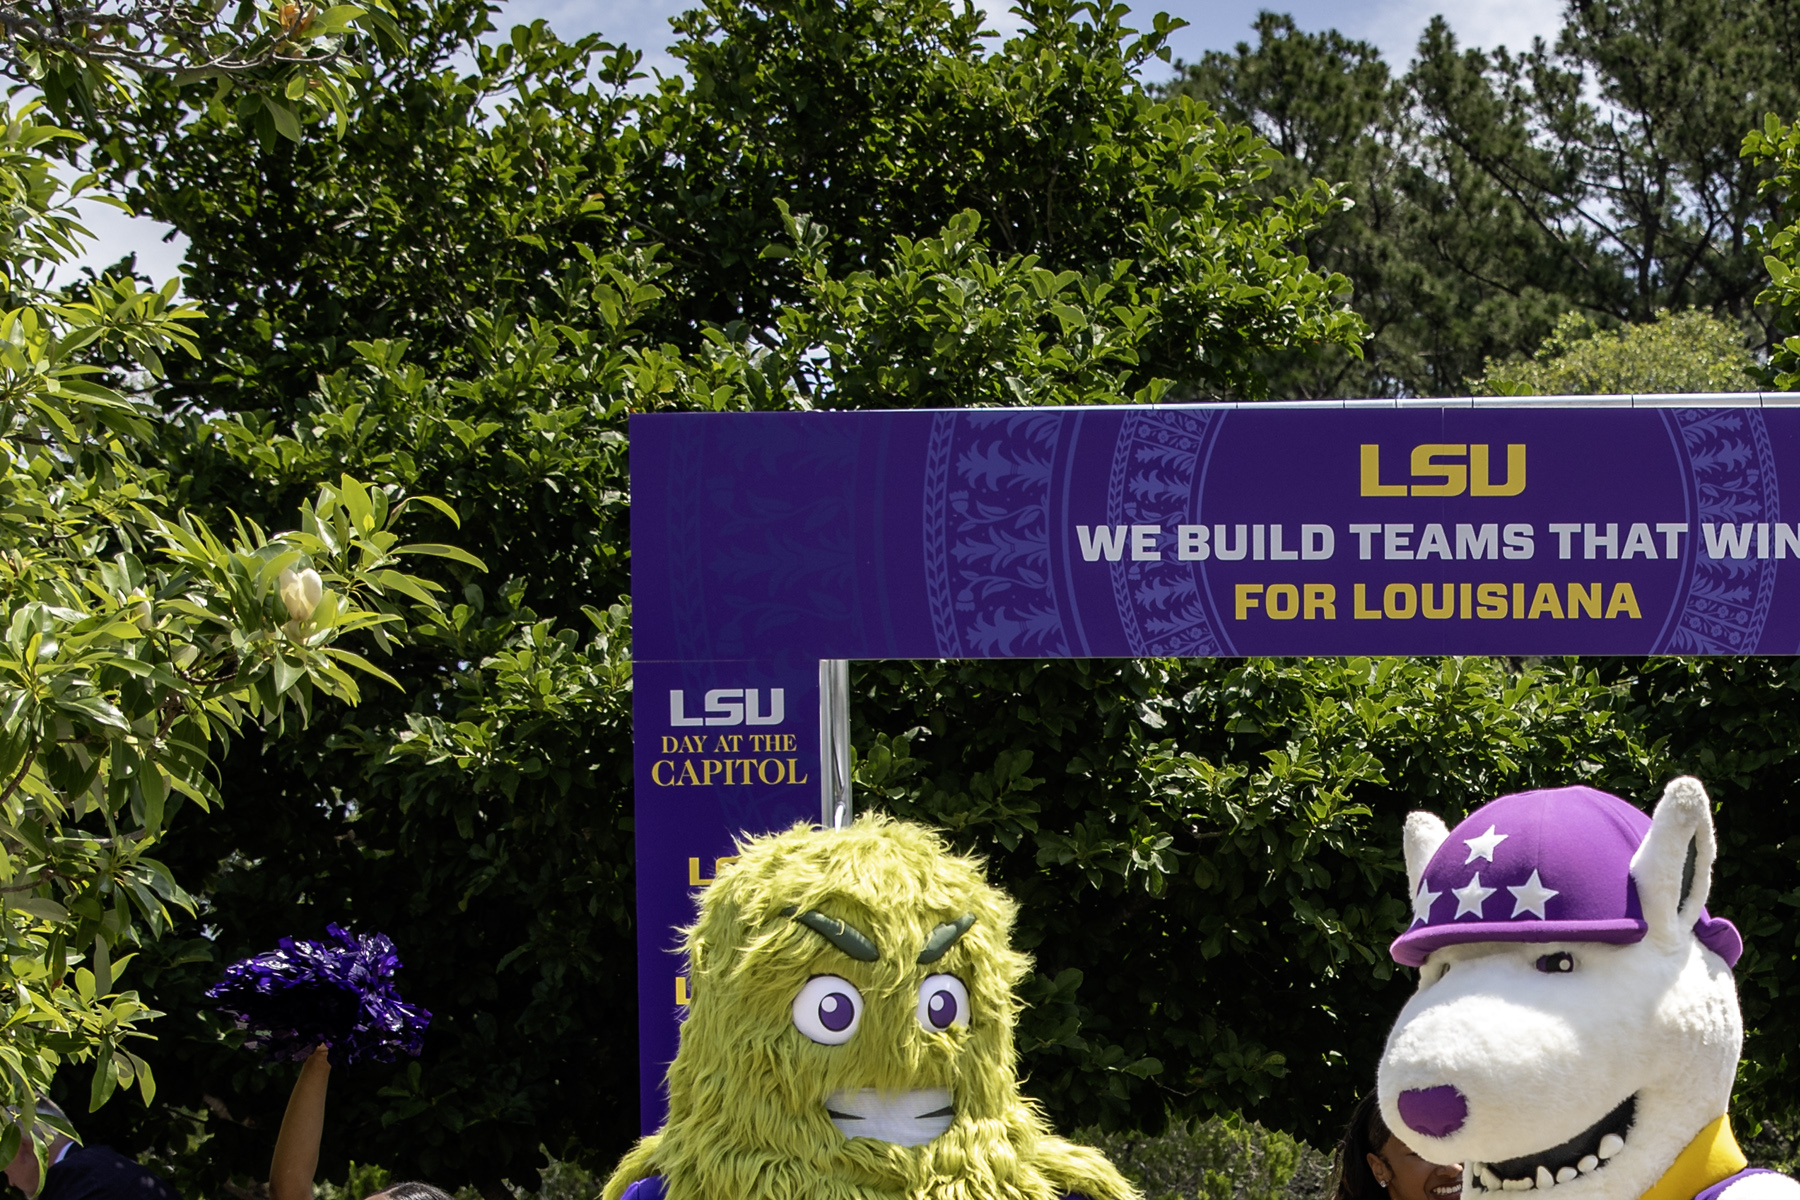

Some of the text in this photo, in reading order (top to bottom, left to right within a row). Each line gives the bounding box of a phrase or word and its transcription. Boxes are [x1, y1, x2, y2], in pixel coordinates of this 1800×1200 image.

[1361, 444, 1527, 497] LSU
[1076, 524, 1162, 562] WE
[1178, 524, 1335, 561] BUILD
[1350, 523, 1535, 561] TEAMS
[1549, 522, 1689, 560] THAT
[1235, 582, 1643, 621] FOR LOUISIANA
[670, 688, 785, 727] LSU
[661, 733, 797, 754] DAY AT THE
[651, 758, 808, 787] CAPITOL
